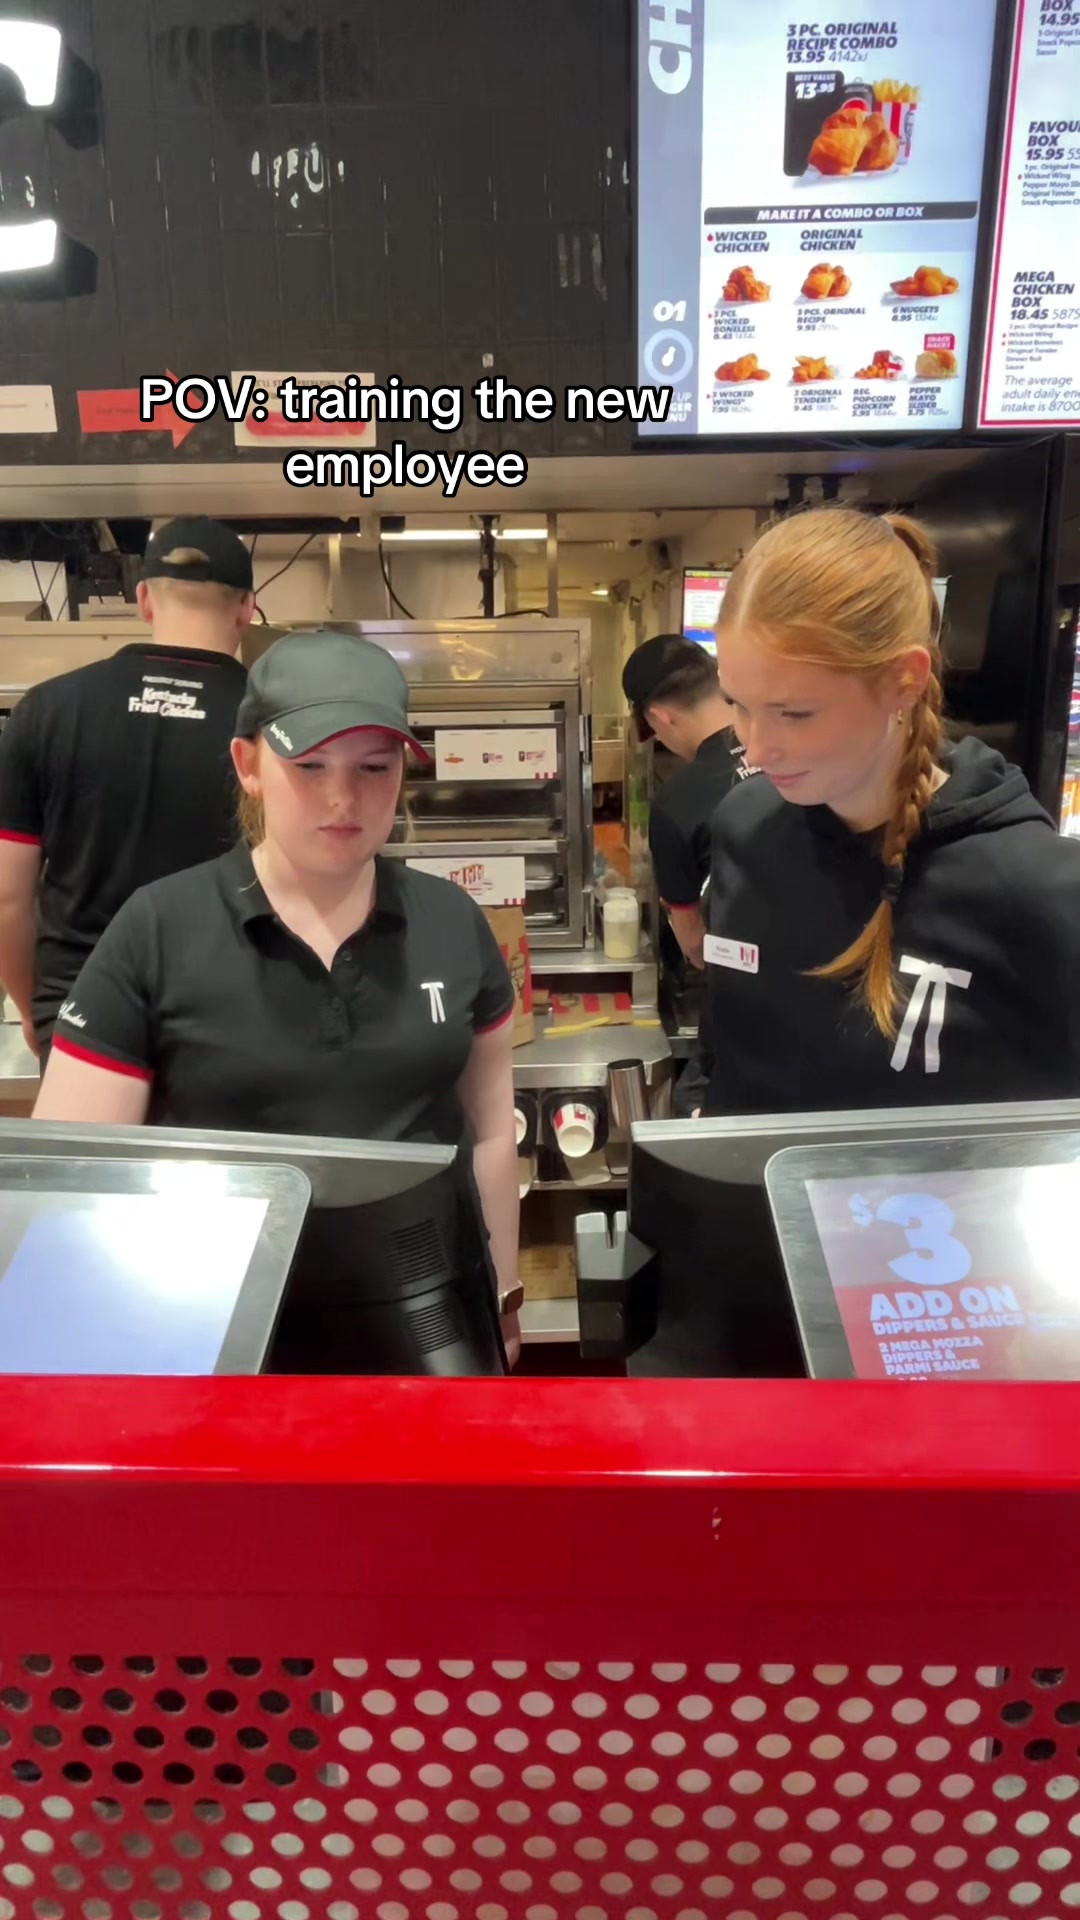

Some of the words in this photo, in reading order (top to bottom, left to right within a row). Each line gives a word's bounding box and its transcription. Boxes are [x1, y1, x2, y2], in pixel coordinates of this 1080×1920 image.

[1041, 0, 1073, 11] BOX
[1040, 13, 1080, 26] 14.95
[787, 24, 797, 37] 3
[799, 24, 821, 36] PC.
[824, 21, 897, 36] ORIGINAL
[787, 38, 837, 51] RECIPE
[840, 36, 898, 49] COMBO
[787, 51, 825, 63] 13.95
[795, 82, 836, 99] 13.95
[1029, 121, 1080, 133] FAVOU
[1027, 135, 1060, 147] BOX
[1026, 148, 1065, 161] 15.95
[1041, 163, 1069, 171] Original
[1052, 172, 1071, 181] Wing
[1022, 190, 1050, 198] Original
[757, 210, 797, 221] MAKE
[798, 209, 811, 219] IT
[812, 209, 821, 220] A
[823, 207, 873, 219] COMBO
[875, 207, 894, 218] OR
[896, 206, 924, 218] BOX
[715, 231, 768, 241] WICKED
[801, 229, 864, 240] ORIGINAL
[714, 242, 770, 253] CHICKEN
[800, 240, 856, 251] CHICKEN
[1014, 271, 1056, 282] MEGA
[1013, 284, 1075, 295] CHICKEN
[1011, 296, 1043, 308] BOX
[653, 300, 687, 322] 01
[823, 307, 866, 315] ORIGINAL
[900, 306, 940, 314] NUGGETS
[1010, 308, 1049, 320] 18.45
[797, 316, 828, 324] RECIPE
[1056, 322, 1079, 330] Recipe
[1005, 375, 1026, 386] The
[1027, 377, 1073, 388] average
[677, 392, 692, 401] UP
[1002, 389, 1032, 399] adult
[1033, 389, 1061, 401] daily
[1001, 403, 1036, 412] intake
[1038, 402, 1046, 412] is
[142, 687, 197, 708] Kentucky
[128, 696, 160, 712] Fried
[160, 702, 206, 719] Chicken
[876, 1193, 972, 1285] 3
[870, 1291, 953, 1321] ADD
[959, 1285, 1019, 1314] ON
[873, 1316, 949, 1335] DIPPERS
[951, 1318, 966, 1330] &
[967, 1313, 1024, 1328] SAUCE
[879, 1343, 889, 1353] 2
[892, 1339, 930, 1351] MEGA
[932, 1336, 984, 1349] MOZZA
[882, 1351, 944, 1365] DIPPERS
[945, 1350, 956, 1360] &
[885, 1363, 932, 1376] PARMI
[933, 1359, 980, 1371] SAUCE
